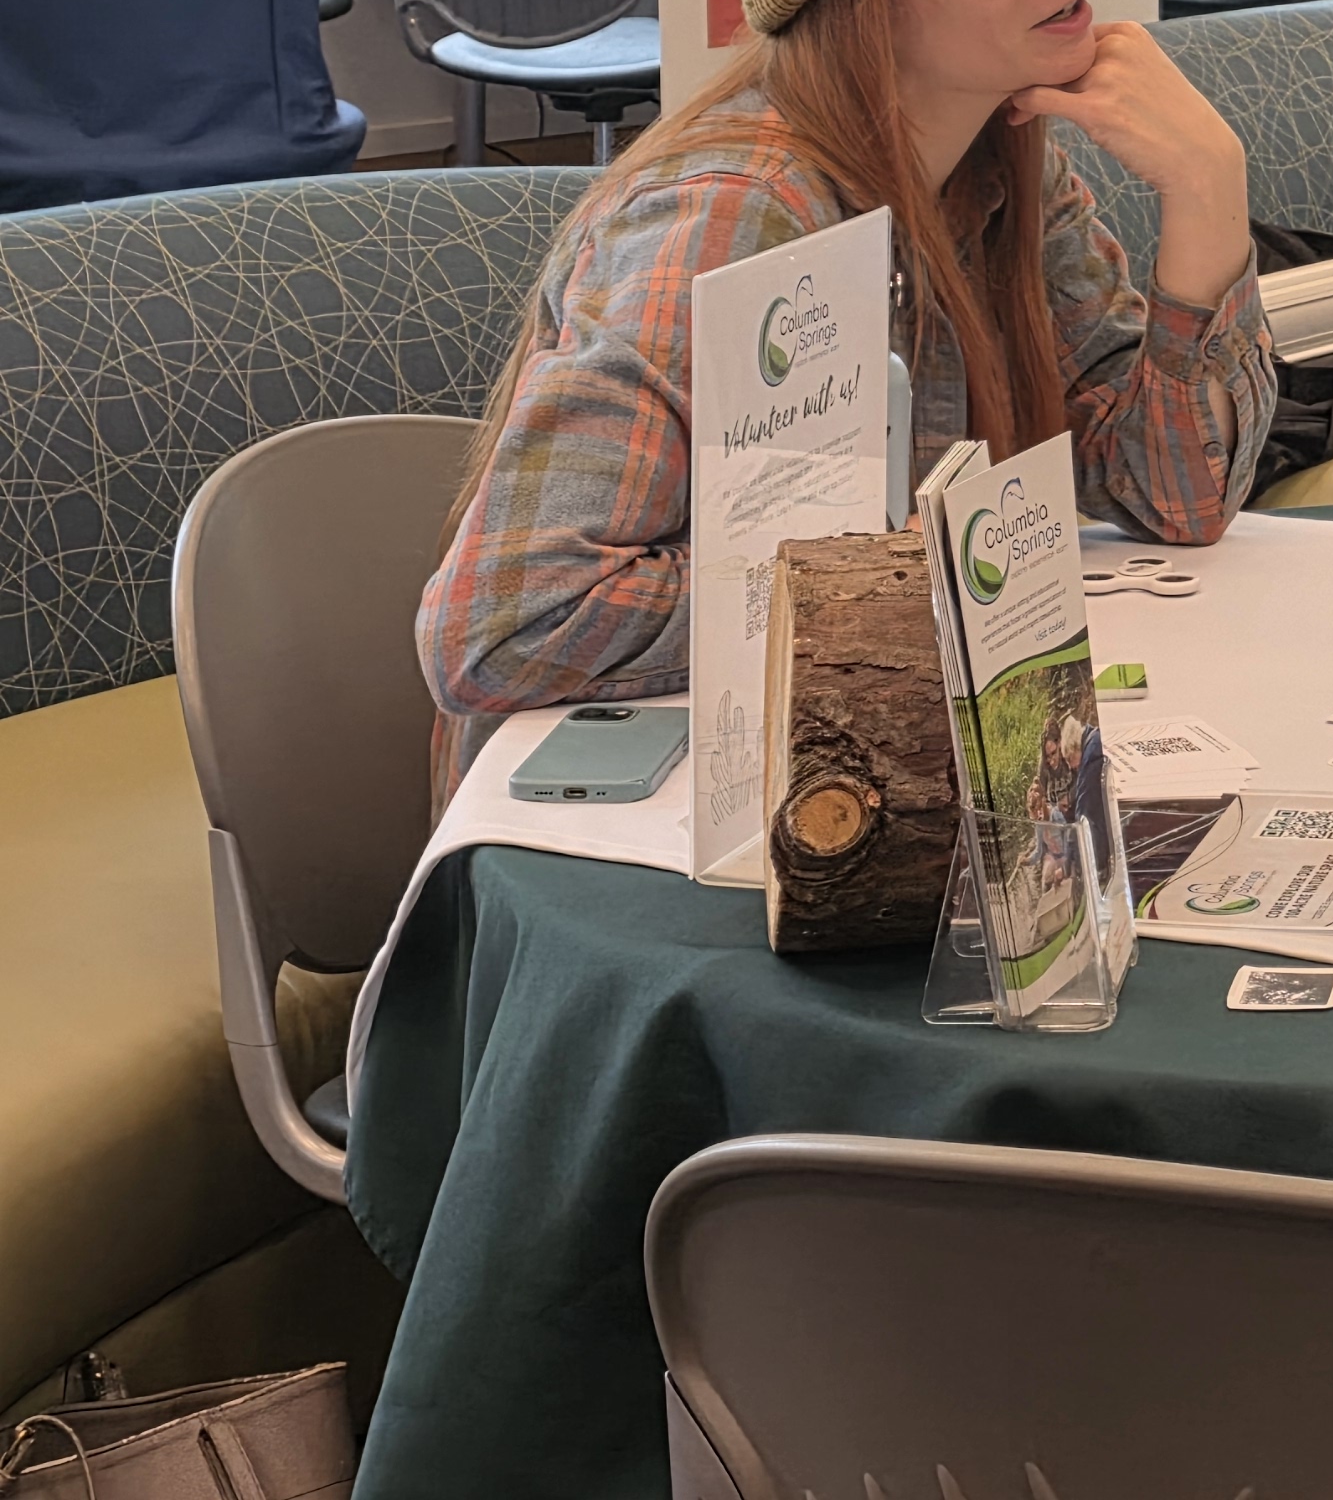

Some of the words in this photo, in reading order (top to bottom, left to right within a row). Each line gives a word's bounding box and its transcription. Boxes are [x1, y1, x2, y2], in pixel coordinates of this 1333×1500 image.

[779, 302, 829, 336] Columbia
[799, 322, 838, 356] Springs
[724, 405, 798, 459] Volunteer
[803, 374, 836, 419] with
[984, 503, 1048, 549] Columbia
[1012, 522, 1063, 563] Springs
[1265, 902, 1289, 918] COME
[1278, 877, 1307, 901] EXPLORE
[1296, 865, 1317, 877] OUR
[1284, 894, 1313, 918] 100-ACRE
[1301, 871, 1329, 893] NATURE
